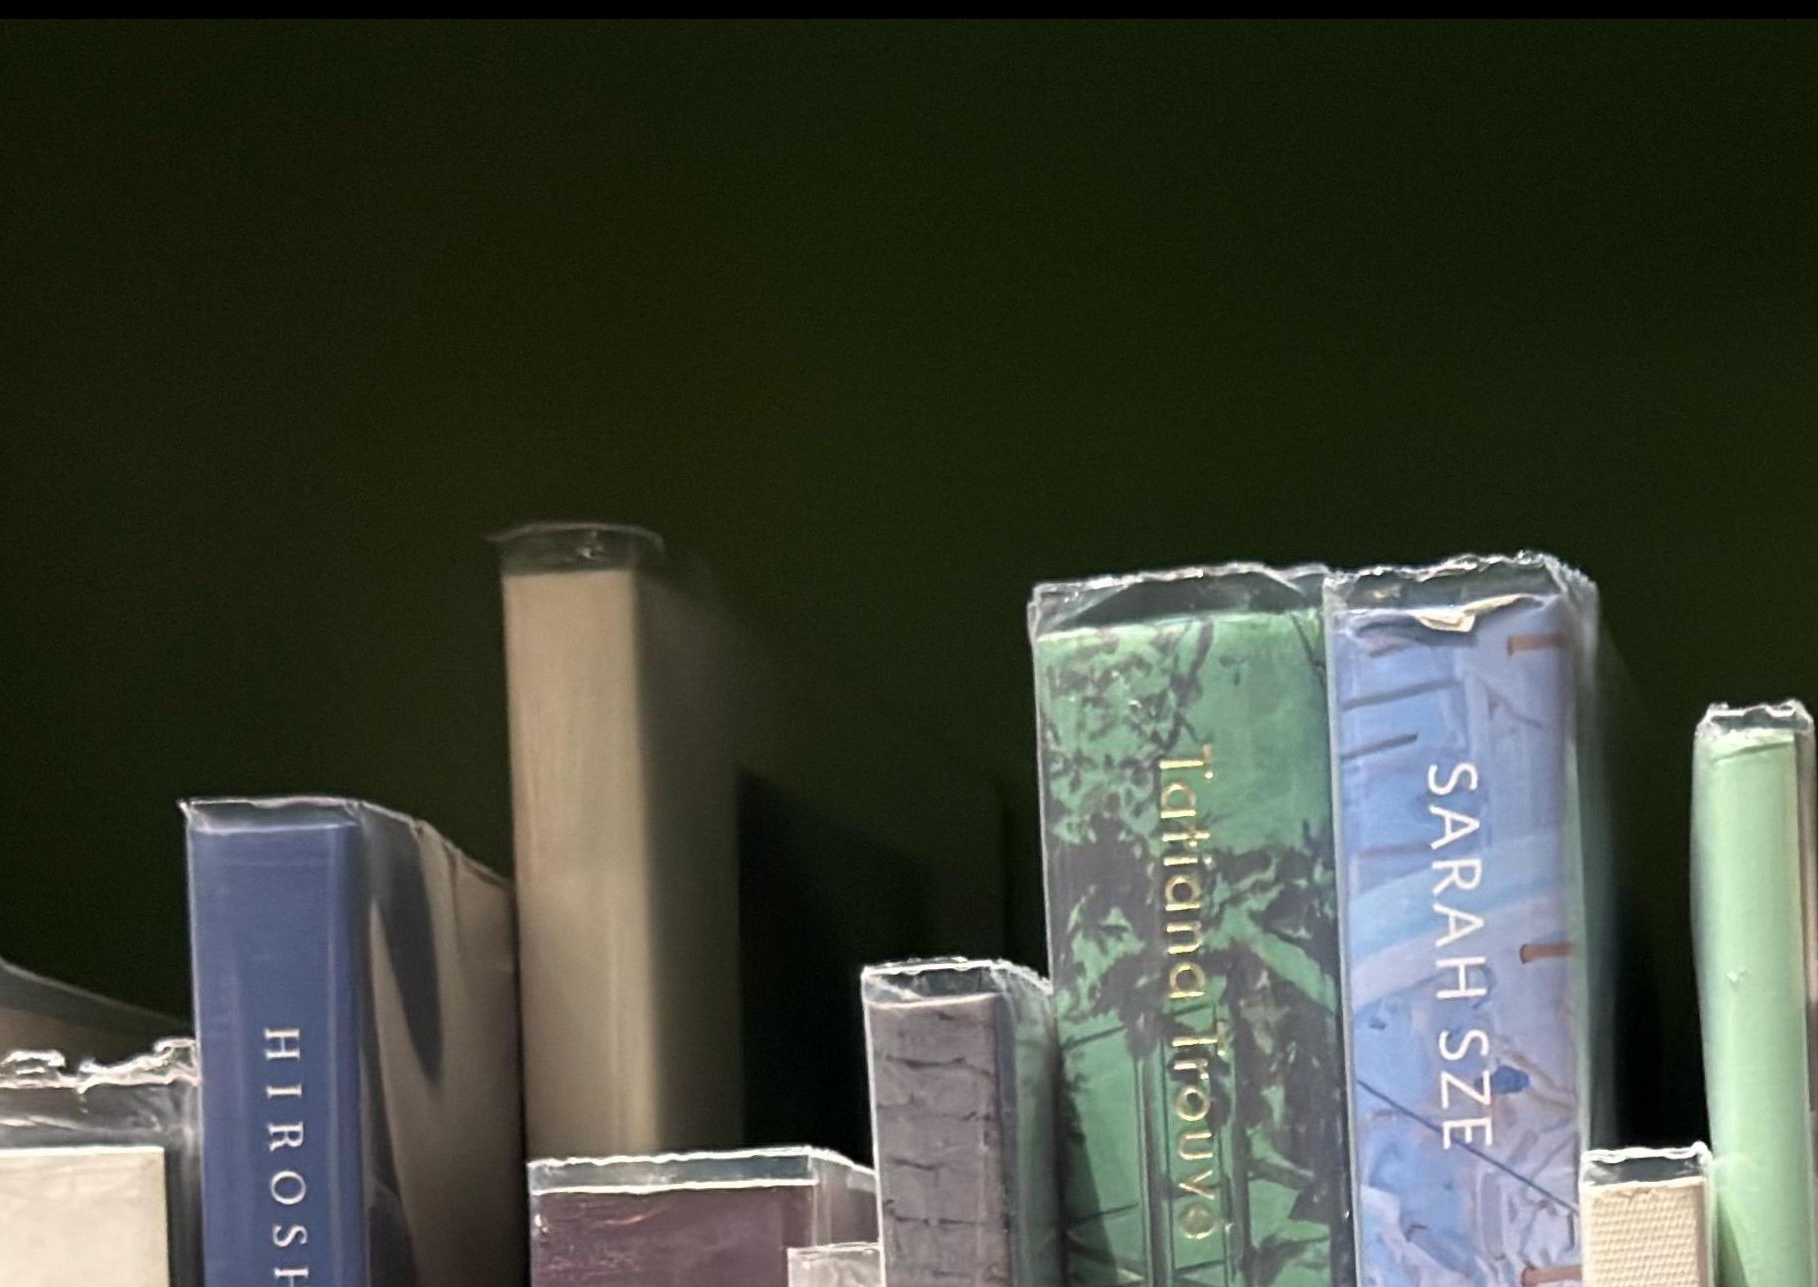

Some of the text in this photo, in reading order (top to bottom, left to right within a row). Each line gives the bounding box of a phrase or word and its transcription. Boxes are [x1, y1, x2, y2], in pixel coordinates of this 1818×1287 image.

[1156, 743, 1216, 1001] Tatiana
[1426, 763, 1494, 1150] SARAH SZE
